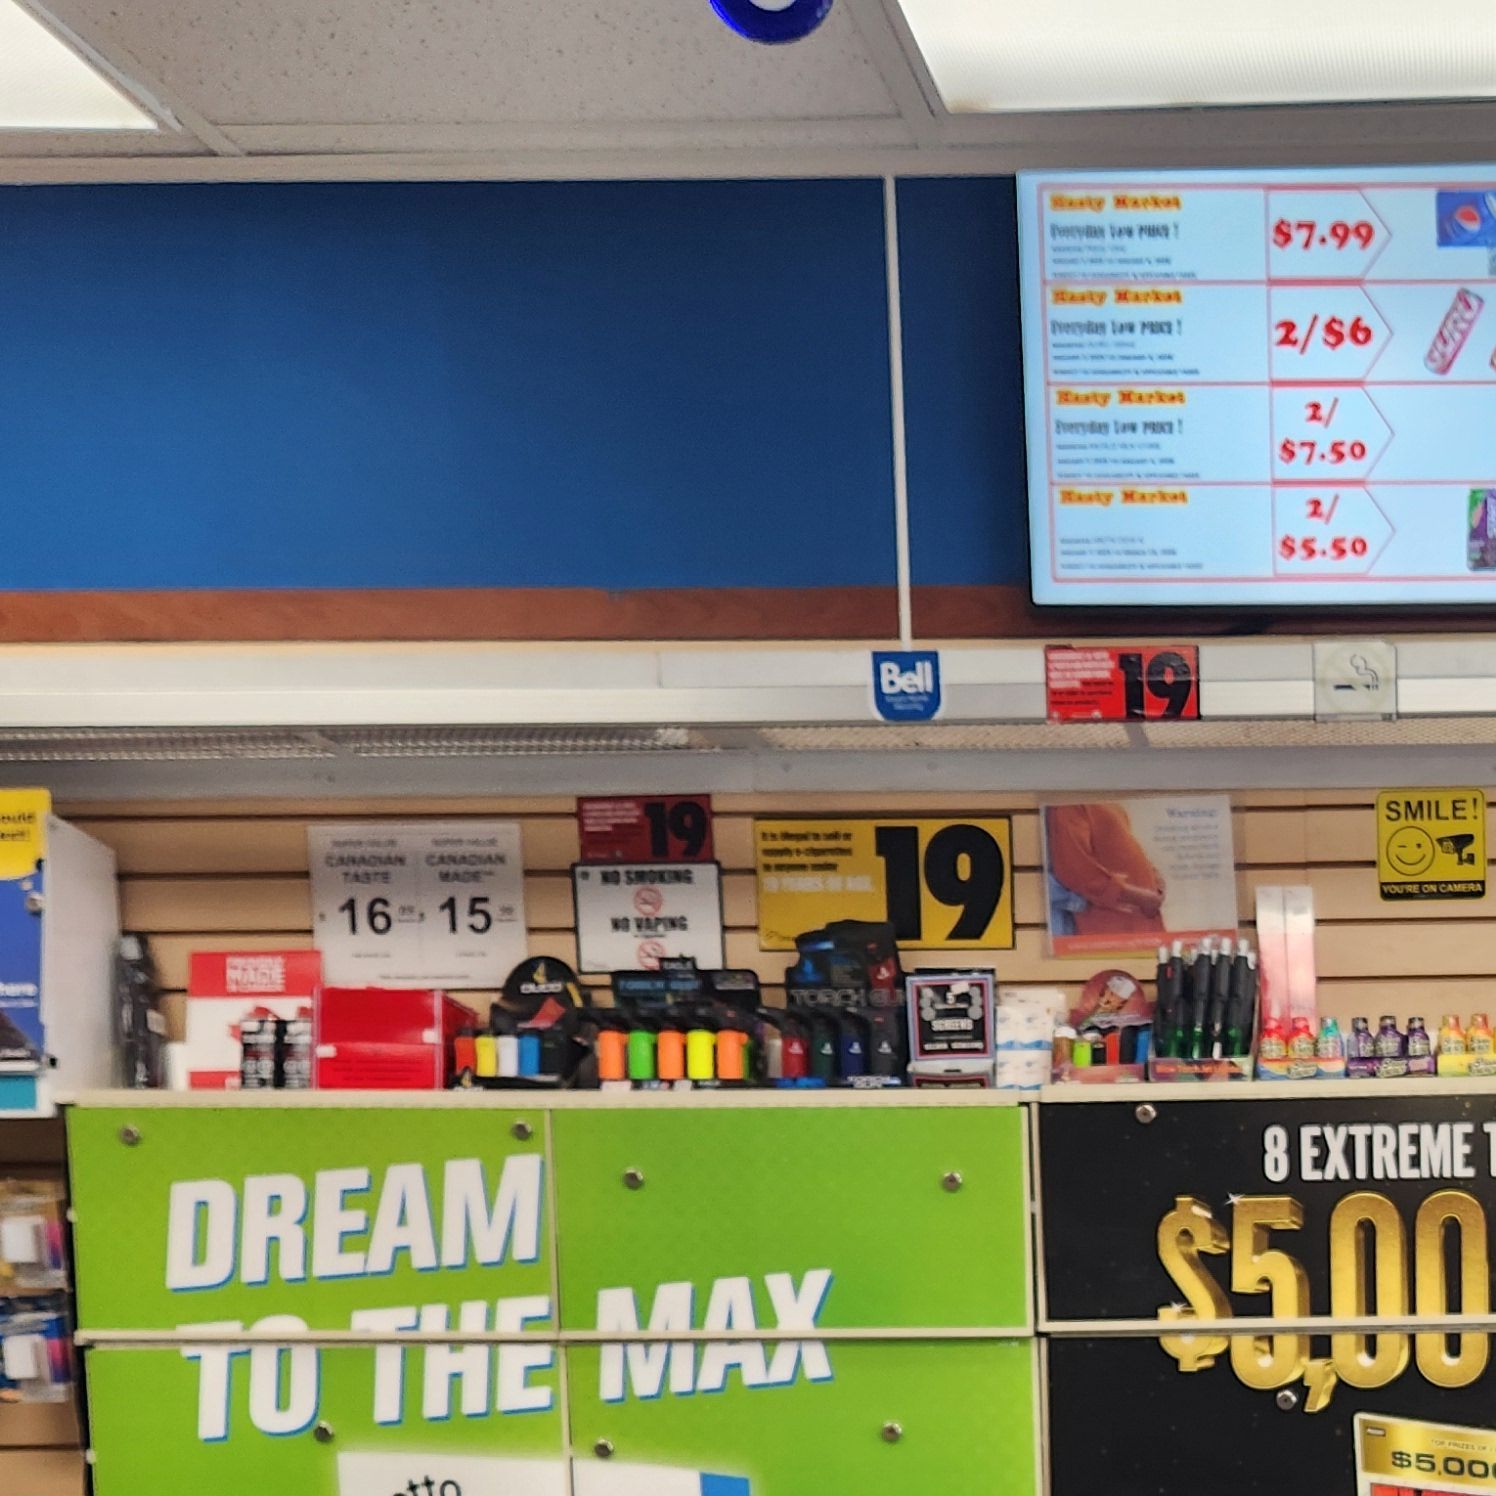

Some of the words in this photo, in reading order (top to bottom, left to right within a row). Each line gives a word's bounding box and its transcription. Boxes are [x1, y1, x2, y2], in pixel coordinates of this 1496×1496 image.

[1272, 218, 1375, 249] $7.99
[1276, 314, 1372, 355] 2/$6
[1306, 397, 1338, 428] 2/
[1279, 438, 1367, 465] $7.50
[1307, 494, 1339, 525] 2/
[1280, 534, 1368, 561] $5.50
[880, 662, 933, 694] Bell
[1119, 651, 1191, 718] 19
[1385, 798, 1479, 822] SMILE!
[643, 801, 707, 858] 19
[601, 869, 620, 886] NO
[624, 868, 694, 886] SMOKING
[875, 824, 1004, 941] 19
[1381, 882, 1416, 894] YOU'RE
[1418, 882, 1435, 893] ON
[1437, 882, 1482, 894] CAMERA
[338, 897, 392, 935] 16
[439, 896, 492, 933] 15
[611, 916, 632, 932] NO
[634, 915, 689, 932] VAPING
[1263, 1124, 1289, 1182] 8
[1300, 1121, 1475, 1181] EXTREME
[165, 1154, 544, 1291] DREAM
[176, 1314, 322, 1442] TO
[350, 1295, 554, 1426] THE
[598, 1269, 834, 1402] MAX
